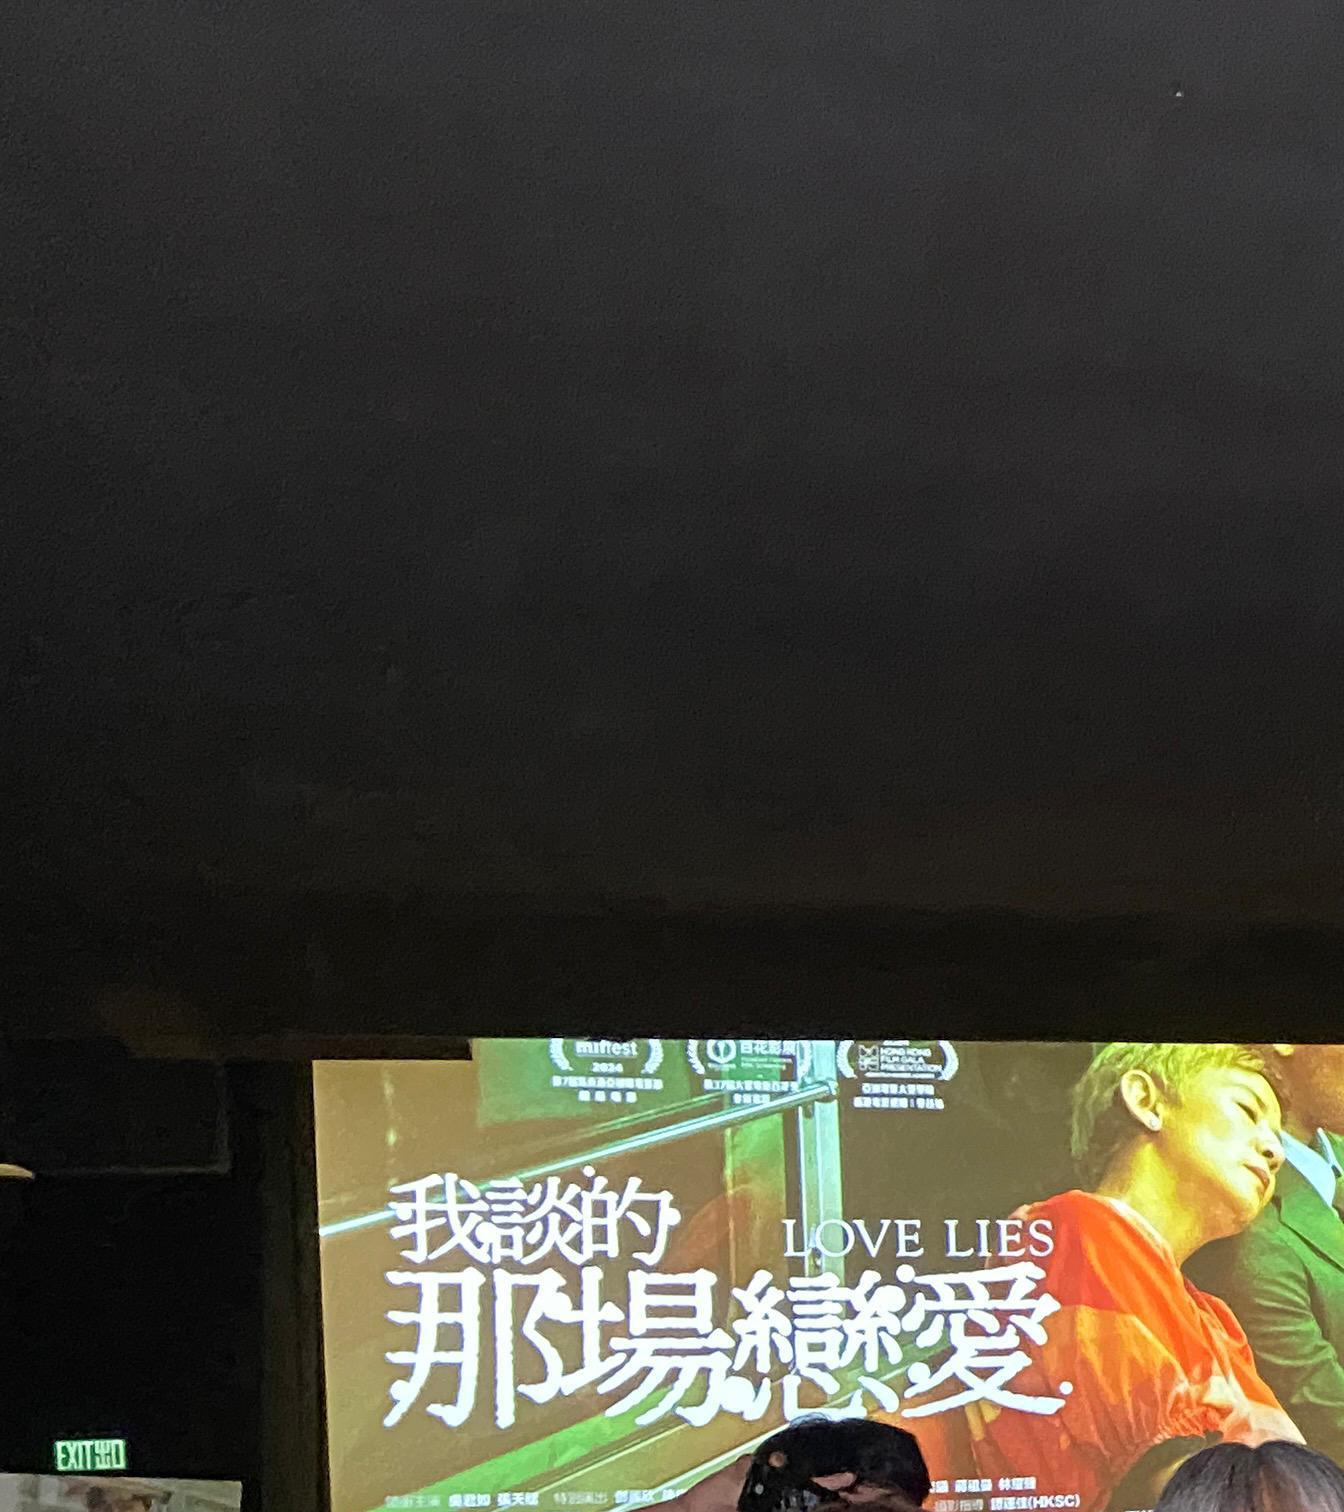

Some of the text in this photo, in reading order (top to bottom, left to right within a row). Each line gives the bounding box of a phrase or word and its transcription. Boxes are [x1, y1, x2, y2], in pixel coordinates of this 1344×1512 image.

[386, 1166, 681, 1267] 我談的
[783, 1218, 1055, 1258] LOVE LIES
[383, 1260, 1074, 1430] 那場戀愛
[56, 1440, 94, 1471] EXIT
